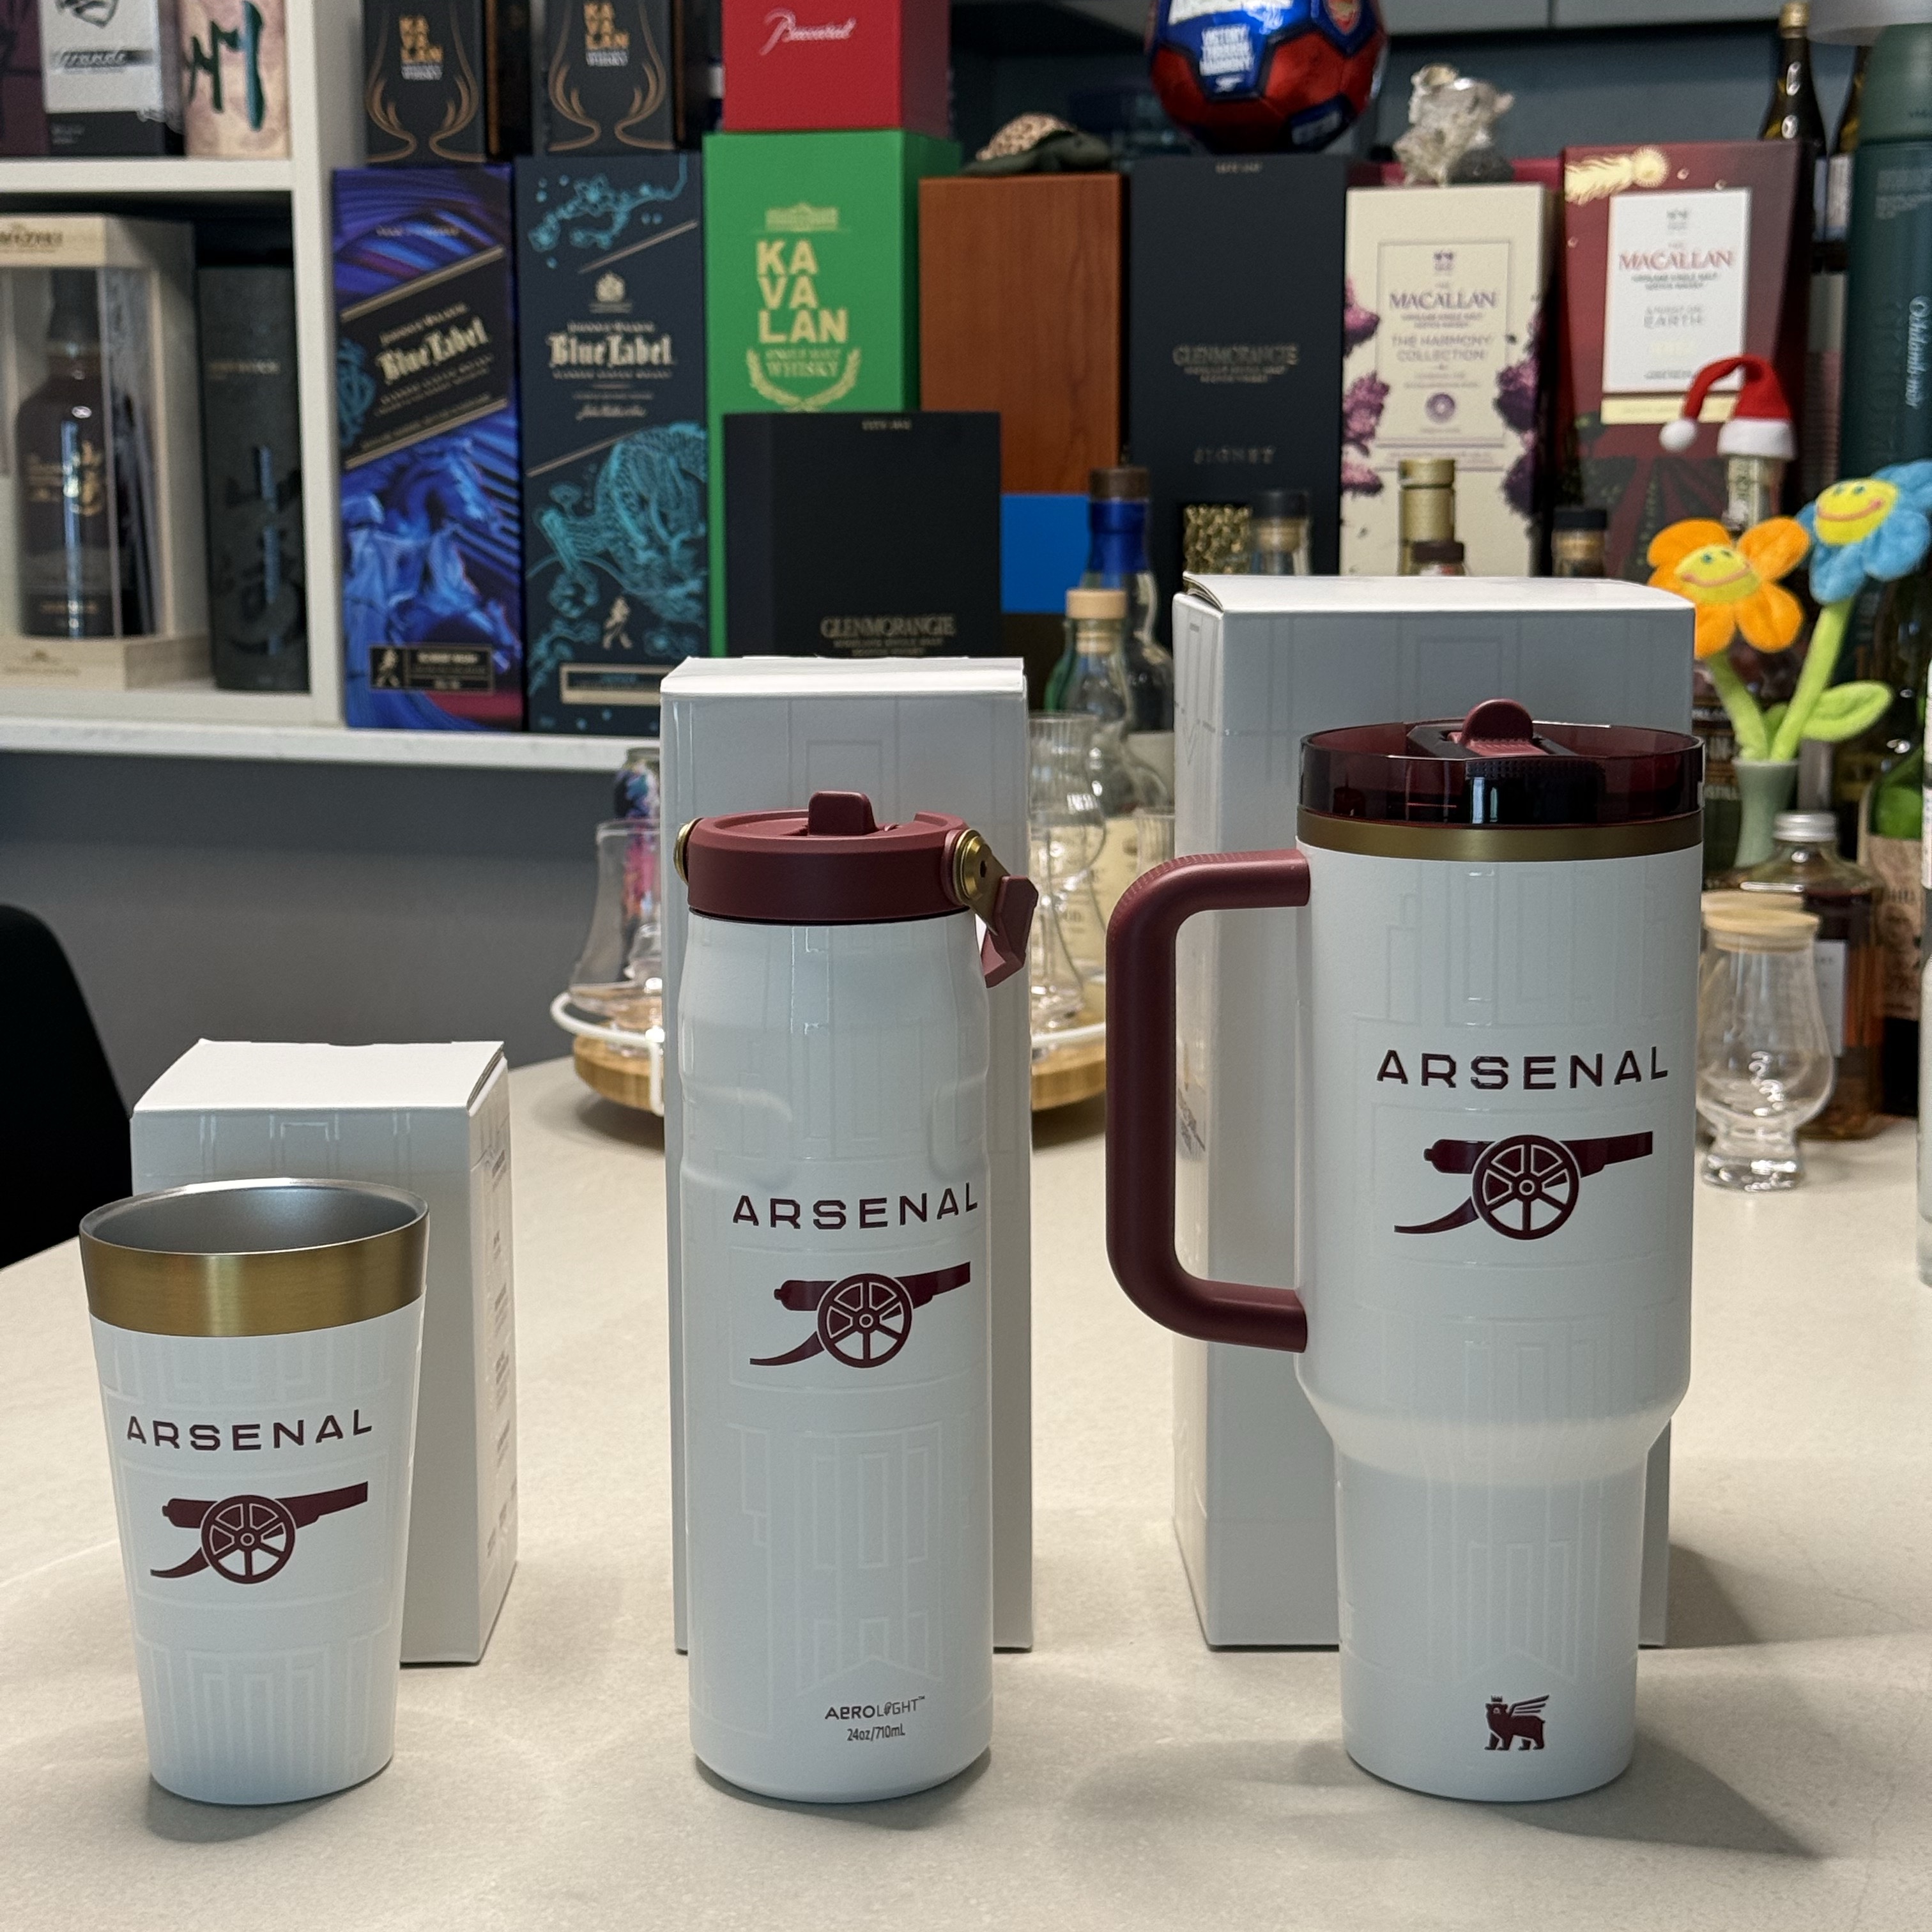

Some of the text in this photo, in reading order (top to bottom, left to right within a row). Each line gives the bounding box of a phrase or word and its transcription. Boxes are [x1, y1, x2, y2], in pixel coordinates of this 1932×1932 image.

[757, 239, 818, 275] KA
[1619, 249, 1735, 270] MACALLAN
[758, 275, 818, 309] VA
[1390, 291, 1497, 310] MACALLAN
[758, 309, 847, 344] LAN
[545, 332, 677, 369] Blue Label
[1376, 1045, 1669, 1090] ARSENAL
[732, 1182, 978, 1230] ARSENAL
[127, 1409, 372, 1451] ARSENAL
